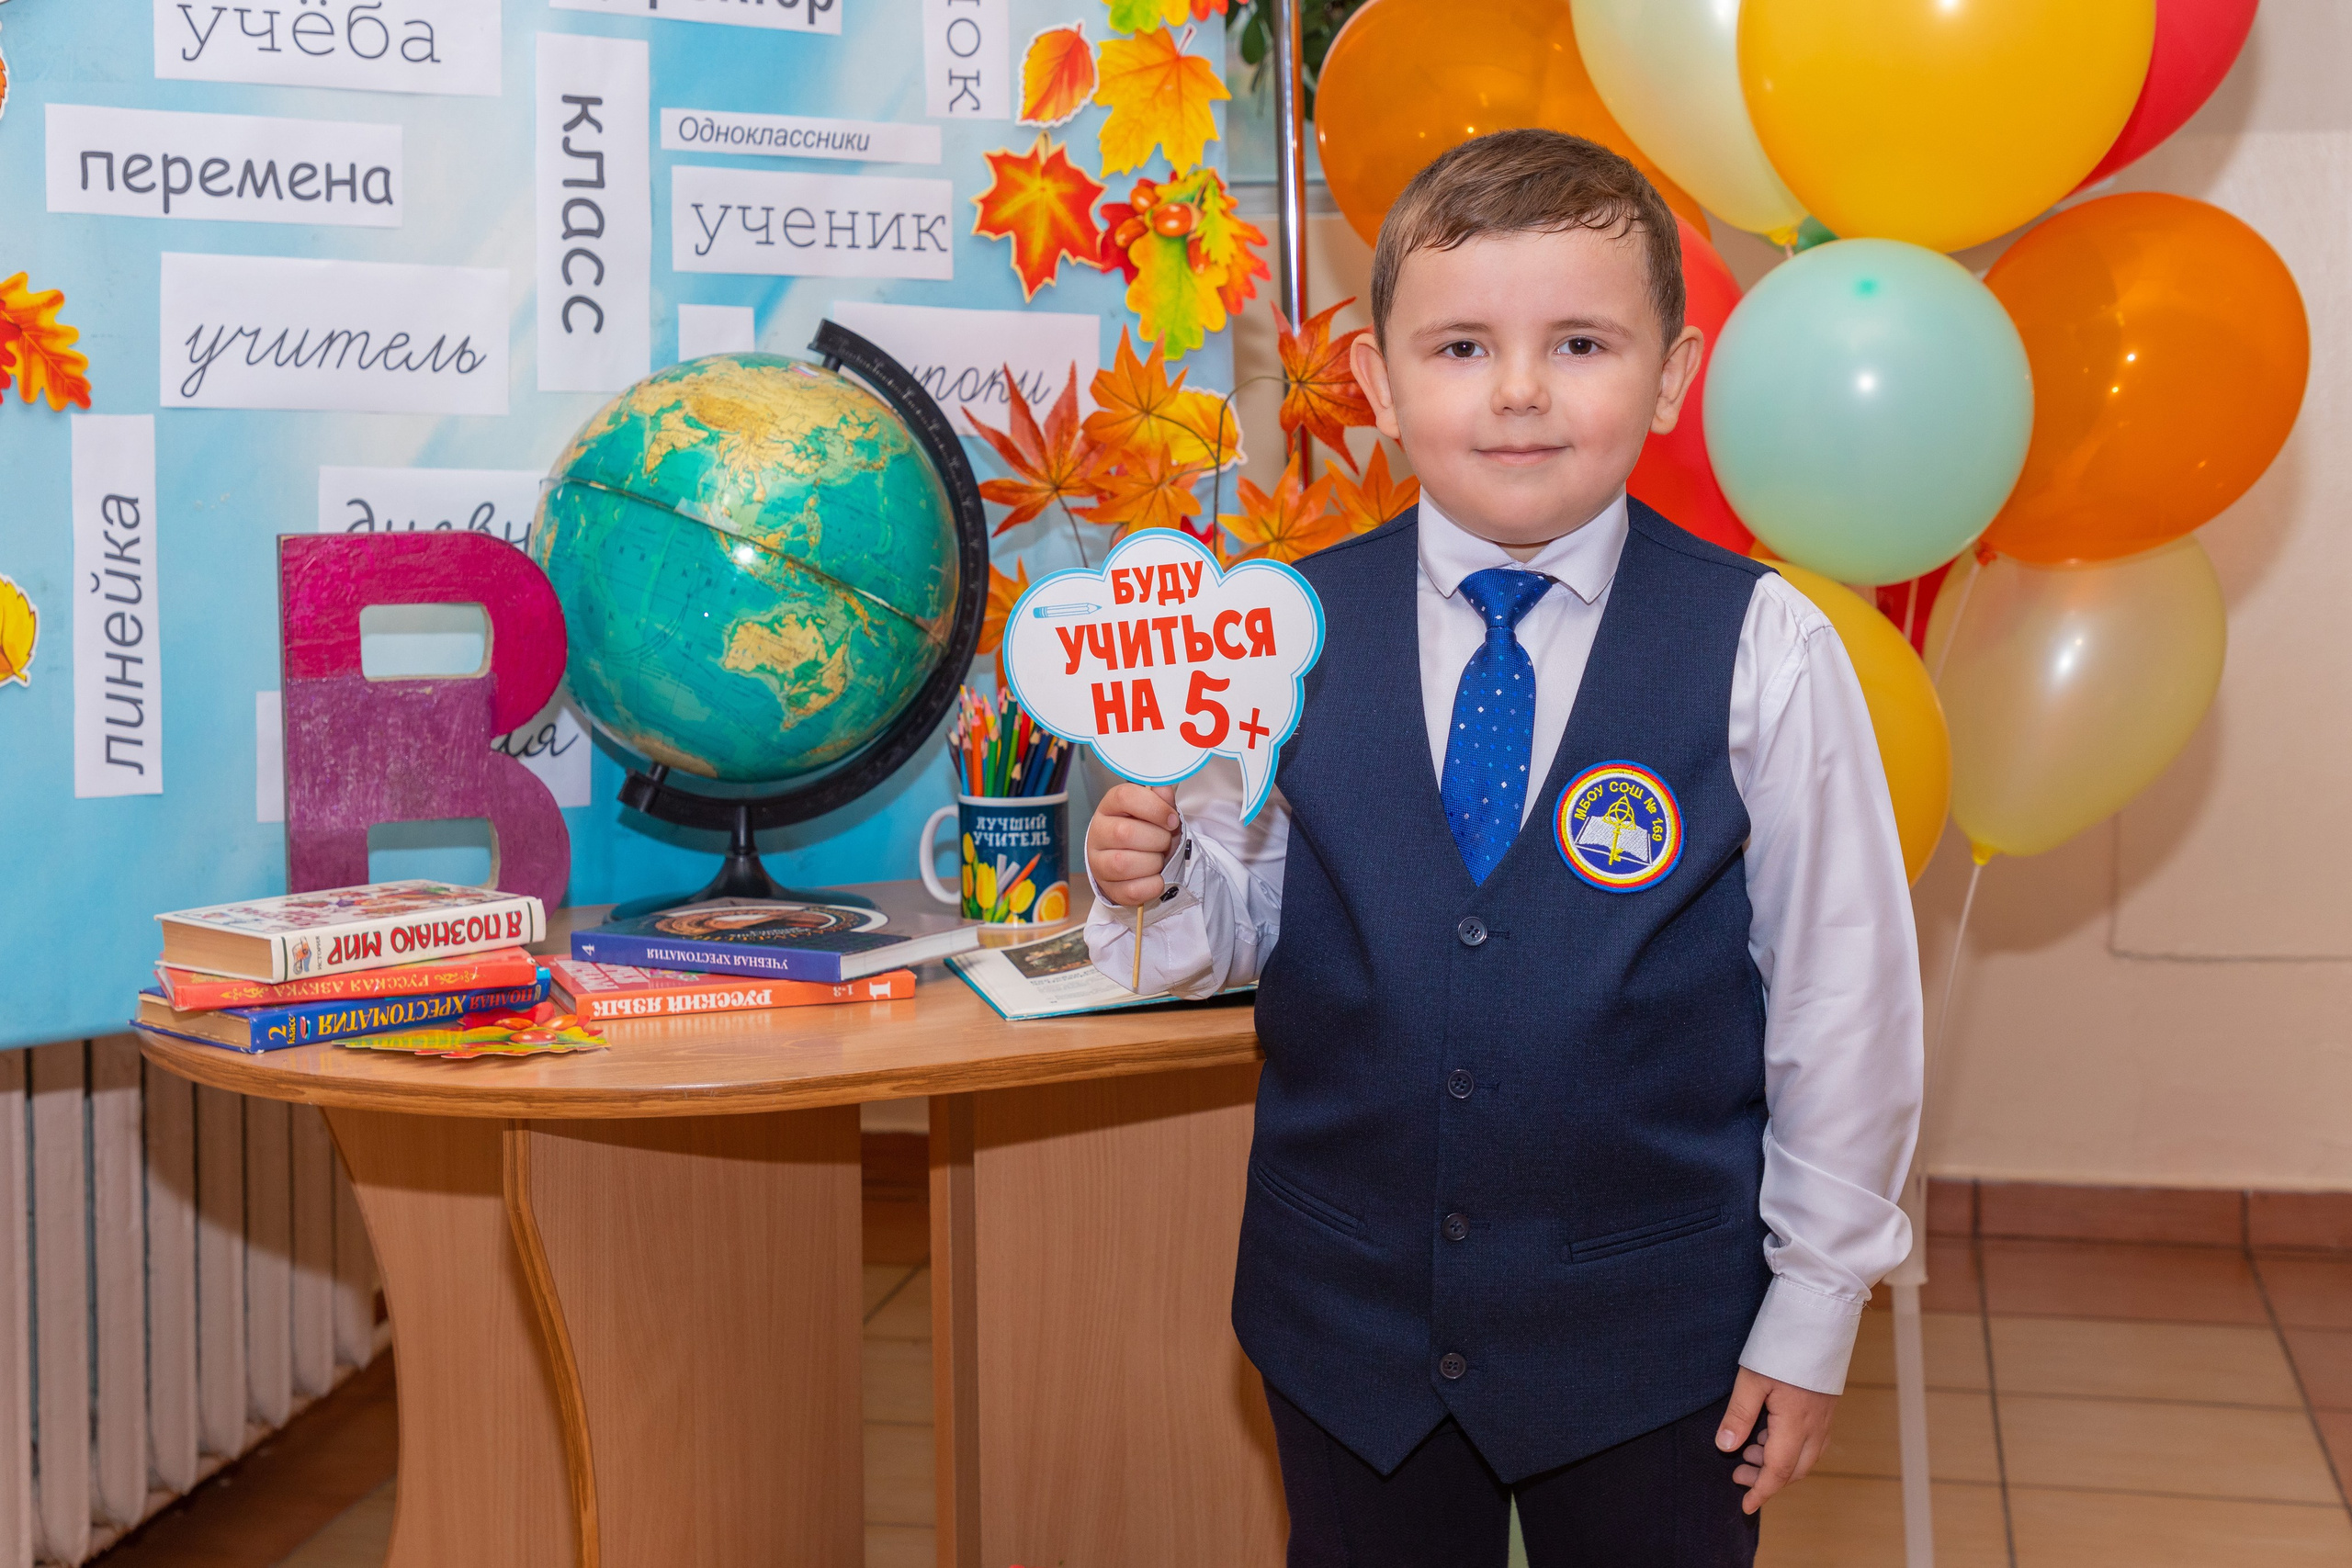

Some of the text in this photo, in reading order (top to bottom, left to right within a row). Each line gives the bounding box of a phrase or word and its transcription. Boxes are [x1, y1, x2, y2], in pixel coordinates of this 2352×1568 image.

[177, 0, 441, 62] учёба
[947, 0, 980, 112] ок
[678, 116, 870, 152] Одноклассники
[79, 148, 393, 214] перемена
[561, 94, 605, 334] класс
[691, 203, 947, 256] ученик
[180, 322, 486, 399] учитель
[1111, 560, 1204, 606] БУДУ
[90, 492, 144, 775] линейка
[1055, 606, 1277, 675] УЧИТЬСЯ
[1091, 678, 1165, 736] НА
[977, 813, 1047, 831] ЛУЧШИЙ
[1574, 781, 1664, 841] МБОУ СОШ № 169
[973, 831, 1050, 847] УЧИТЕЛЬ
[314, 935, 322, 971] ИСТОРИЯ
[327, 910, 522, 965] Я ПОЗНАЮ МИР
[582, 943, 595, 957] 4
[646, 948, 788, 970] УЧЕБНАЯ ХРЕСТОМАТИЯ
[275, 971, 430, 997] РУССКАЯ АЗБУКА
[592, 988, 773, 1017] РУССКИЙ ЯЗЫК
[832, 983, 854, 998] 1-3
[267, 1024, 287, 1041] 2
[318, 986, 533, 1036] ПОЛНАЯ ХРЕСТОМАТИЯ
